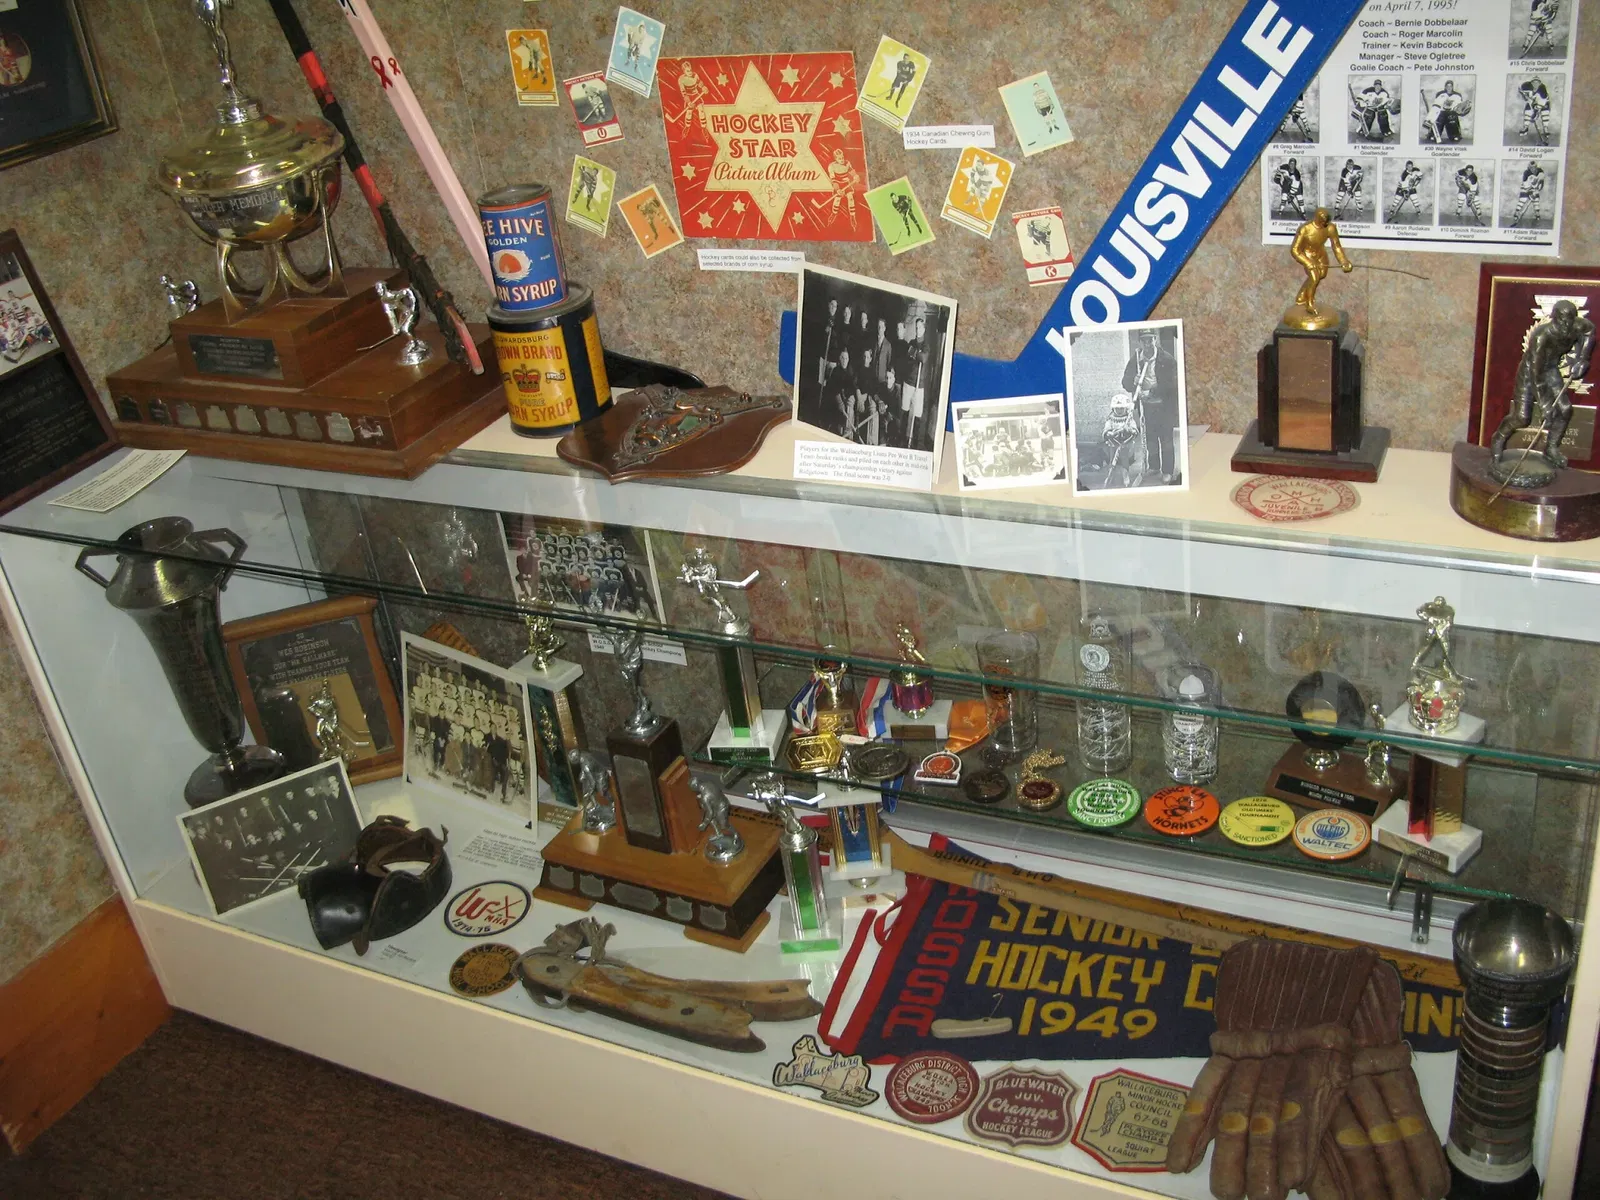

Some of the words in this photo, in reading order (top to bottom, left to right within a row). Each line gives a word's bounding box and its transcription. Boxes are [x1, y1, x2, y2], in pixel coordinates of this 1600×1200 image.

[1384, 0, 1411, 13] April
[1414, 1, 1424, 11] 7,
[1427, 0, 1458, 10] 1995!
[1394, 19, 1422, 27] Bernie
[1424, 18, 1468, 26] Dobbelaar
[1362, 30, 1389, 38] Coach
[1398, 30, 1424, 39] Roger
[1426, 29, 1463, 38] Marcolin
[1362, 41, 1391, 49] Trainer
[1400, 41, 1424, 49] Kevin
[1426, 40, 1463, 49] Babcock
[1359, 52, 1394, 61] Manager
[1404, 52, 1427, 60] Steve
[1429, 52, 1466, 61] Ogletree
[1349, 63, 1376, 71] Goalie
[1378, 63, 1404, 71] Coach
[1413, 63, 1432, 71] Pete
[1434, 63, 1475, 71] Johnston
[711, 112, 813, 134] HOCKEY
[728, 138, 798, 158] STAR
[713, 161, 764, 181] Picture
[765, 161, 821, 181] Album
[229, 190, 288, 211] MEMORIAL
[499, 218, 545, 236] HIVE
[488, 237, 528, 246] GOLDEN
[511, 278, 557, 302] SYRUP
[522, 345, 562, 360] BRAND
[531, 397, 573, 422] SYRUP
[799, 445, 820, 453] Players
[1153, 816, 1209, 830] HORNETS
[1316, 823, 1346, 838] OILERS
[1302, 837, 1353, 850] WALTEC
[989, 898, 1164, 951] SENIOR
[964, 939, 1167, 1004] HOCKEY
[1018, 996, 1158, 1041] 1949
[775, 1051, 860, 1083] Wallaceburg
[927, 1059, 962, 1076] DISTRICT
[994, 1077, 1066, 1097] BLUEWATER
[1117, 1078, 1179, 1100] WALLACEBURG
[1014, 1091, 1044, 1103] JUV.
[1127, 1090, 1156, 1103] MINOR
[987, 1097, 1059, 1121] Champs
[1129, 1100, 1173, 1118] COUNCIL
[1133, 1112, 1169, 1129] 67-68
[981, 1121, 1018, 1134] HOCKEY
[1019, 1126, 1054, 1139] LEAGUE
[1122, 1129, 1164, 1144] CHAMPS
[1107, 1145, 1138, 1158] LEAGUE
[1124, 1141, 1155, 1155] SQUIRT
